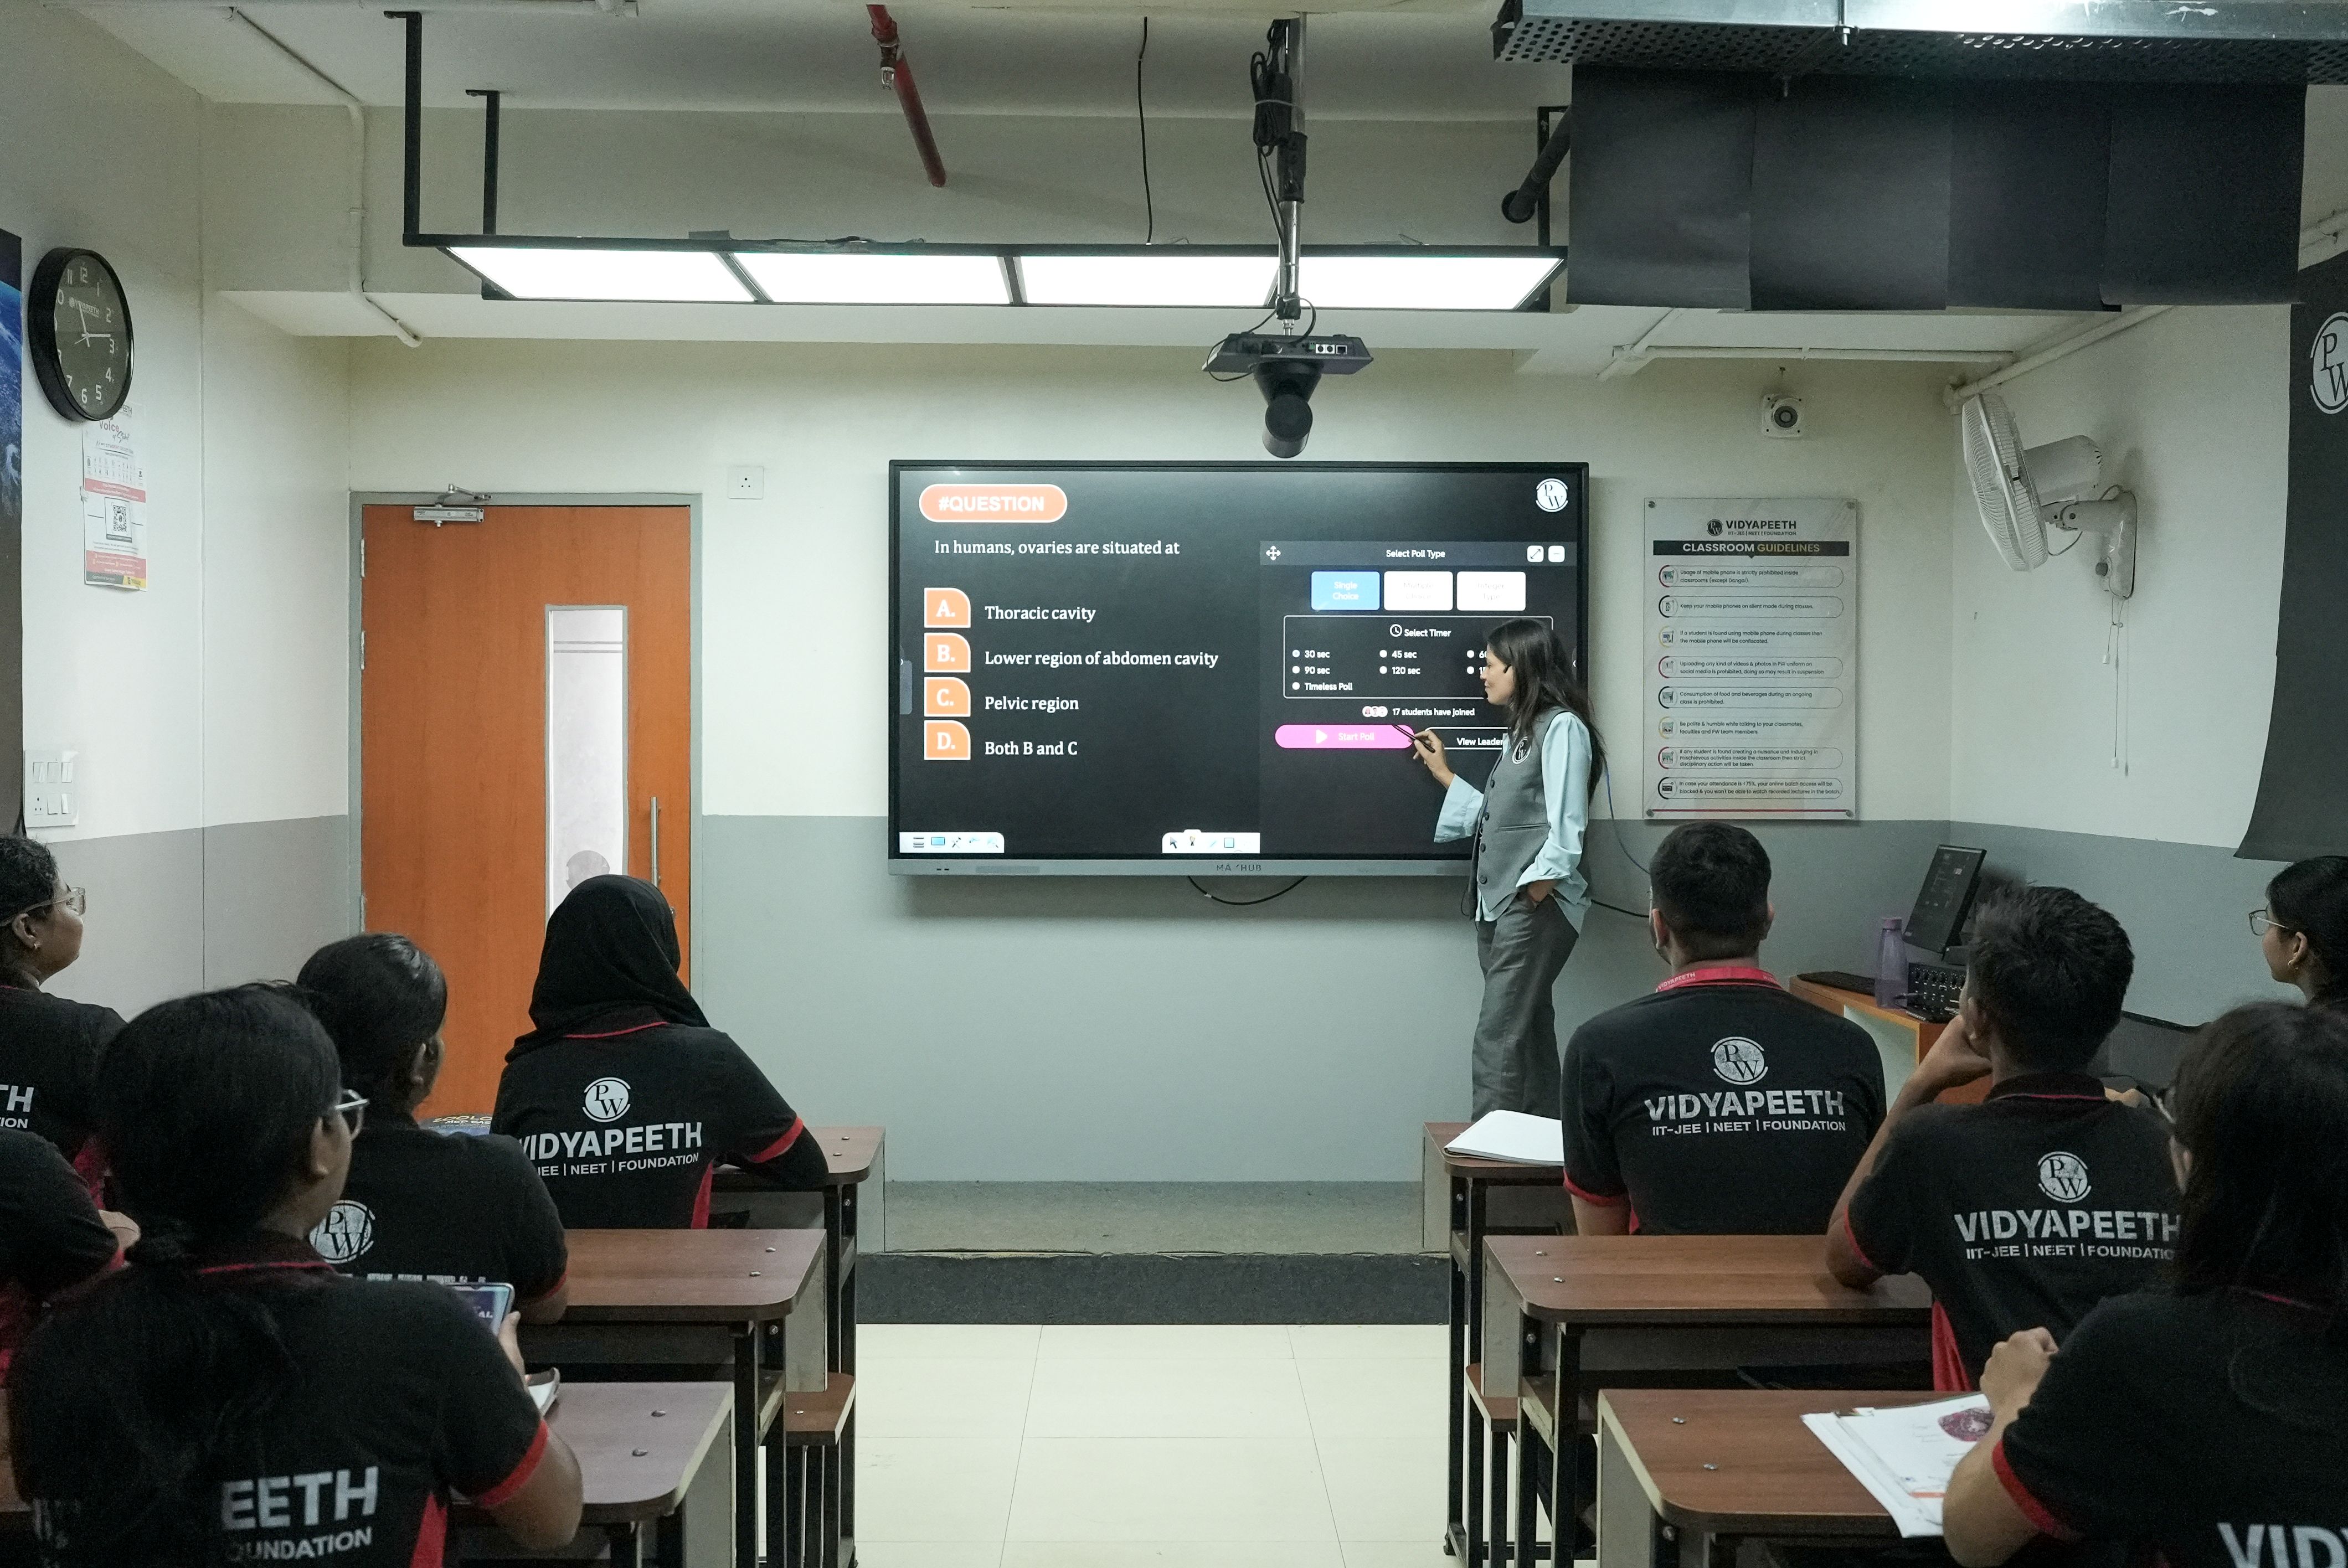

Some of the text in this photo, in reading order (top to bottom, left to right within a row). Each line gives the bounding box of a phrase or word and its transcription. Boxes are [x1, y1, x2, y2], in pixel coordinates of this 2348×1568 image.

[67, 269, 73, 285] 11
[80, 266, 88, 283] 12
[105, 368, 111, 382] 4
[81, 388, 87, 404] 6
[96, 384, 101, 400] 5
[100, 420, 119, 432] Voice
[939, 496, 1044, 512] #QUESTION
[1726, 520, 1796, 529] VIDYAPEETH
[935, 540, 1180, 556] In humans, ovaries are situated at
[1386, 549, 1446, 559] Select Poll Type
[1683, 543, 1820, 553] CLASSROOM GUIDELINES
[1334, 581, 1358, 591] Single
[1332, 592, 1359, 600] Choice
[936, 602, 1096, 623] A. Thoracic cavity
[1404, 628, 1451, 637] Select Timer
[937, 644, 1218, 668] B. Lower region of abdomen cavity
[1304, 650, 1315, 658] 30
[1392, 650, 1402, 658] 45
[1304, 666, 1315, 674] 90
[1392, 666, 1405, 674] 120
[1304, 682, 1353, 691] Timeless Poll
[936, 688, 1079, 713] C. Pelvic region
[1393, 708, 1475, 718] 17 students have joined
[937, 732, 1078, 755] D. Both B and C
[1338, 733, 1374, 741] Start Poll
[1456, 737, 1477, 746] View
[1644, 1090, 1845, 1121] VIDYAPEETH
[1652, 1120, 1846, 1136] IIT-JEE NEET FOUNDATION
[570, 1163, 607, 1175] NEET
[619, 1153, 699, 1171] FOUNDATION
[1954, 1209, 2181, 1242] VIDYAPEETH
[1966, 1245, 2176, 1261] IIT-JEE NEET FOUNDATIO
[2217, 1523, 2348, 1568] VID
